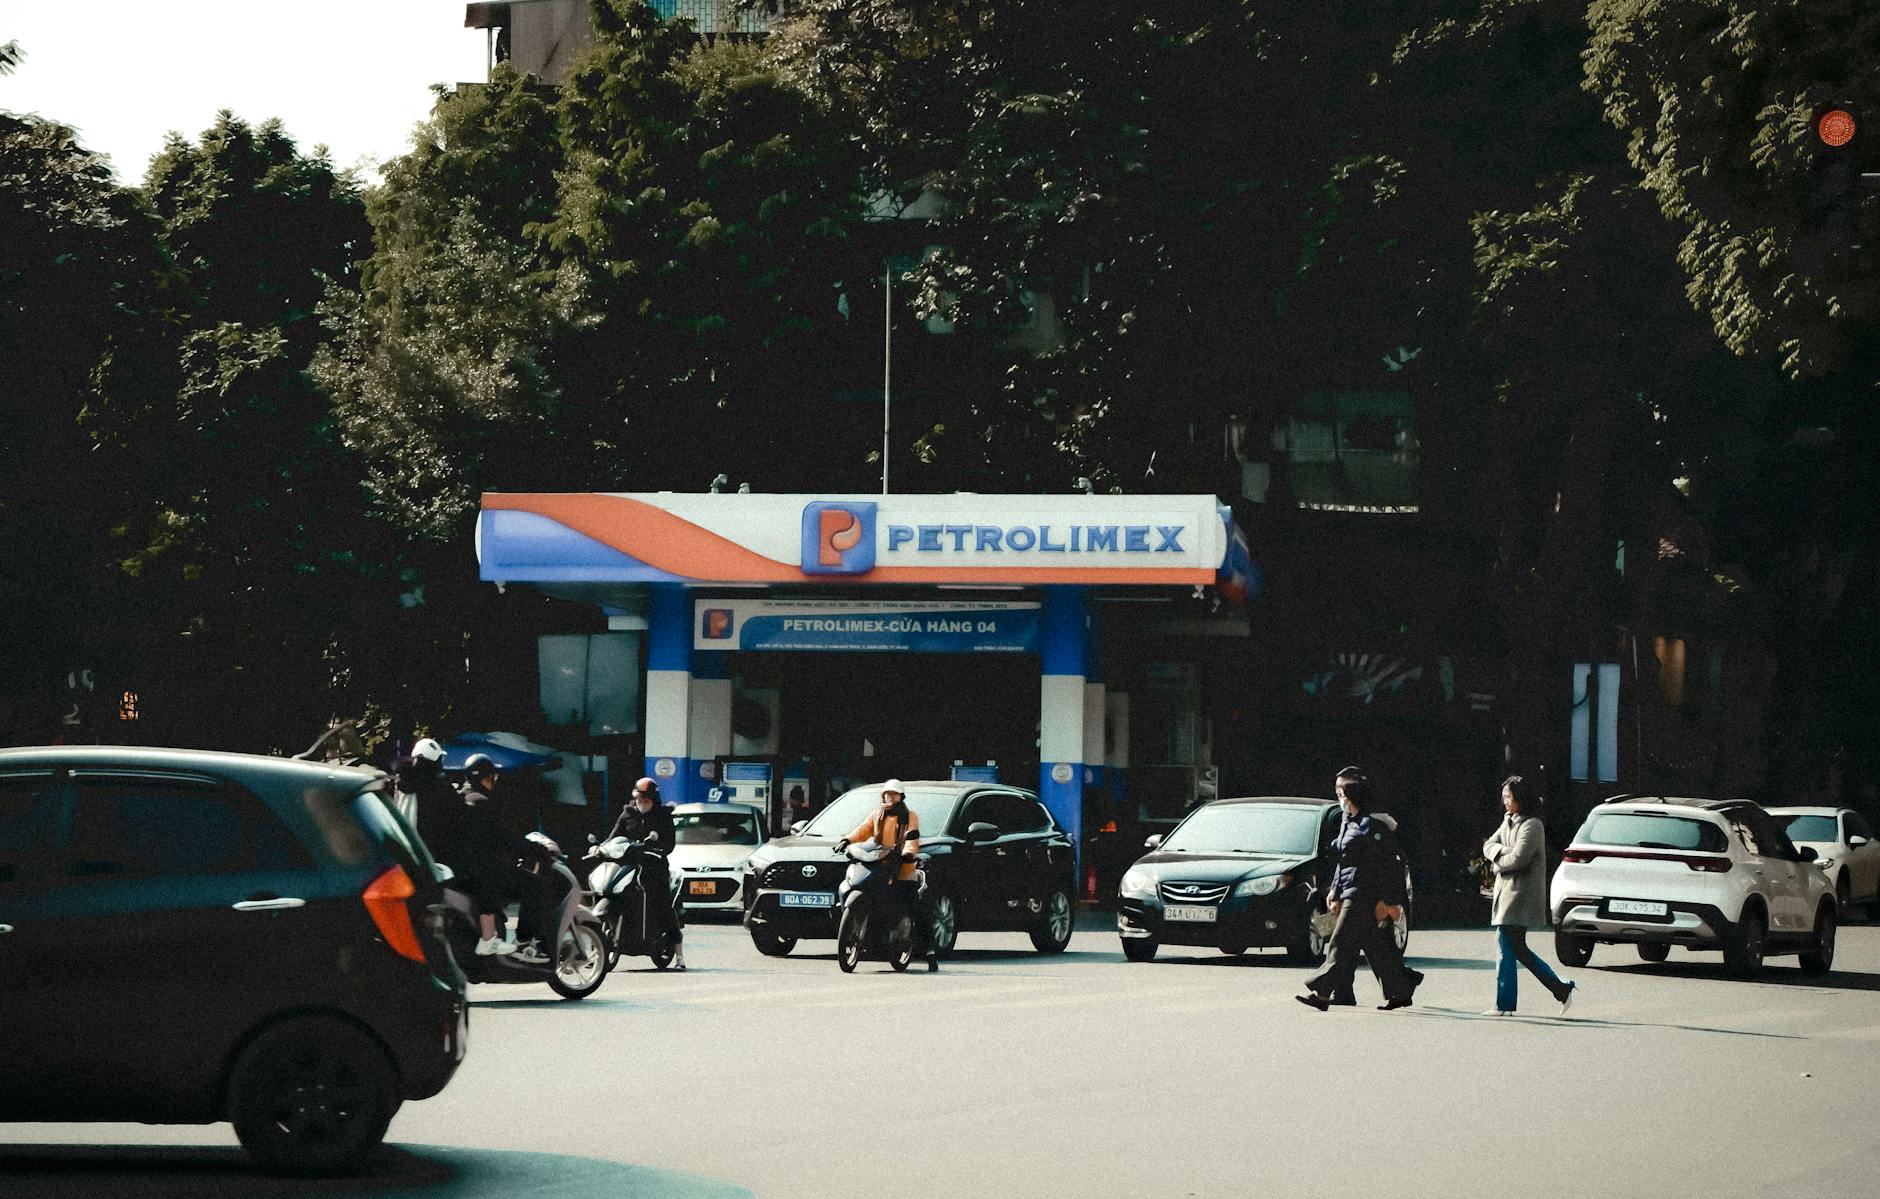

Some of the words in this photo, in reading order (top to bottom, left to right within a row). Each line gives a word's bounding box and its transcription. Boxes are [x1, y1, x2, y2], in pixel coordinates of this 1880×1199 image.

[887, 524, 1186, 553] PETROLIMEX
[926, 618, 973, 634] HÀNG
[977, 621, 997, 634] 04
